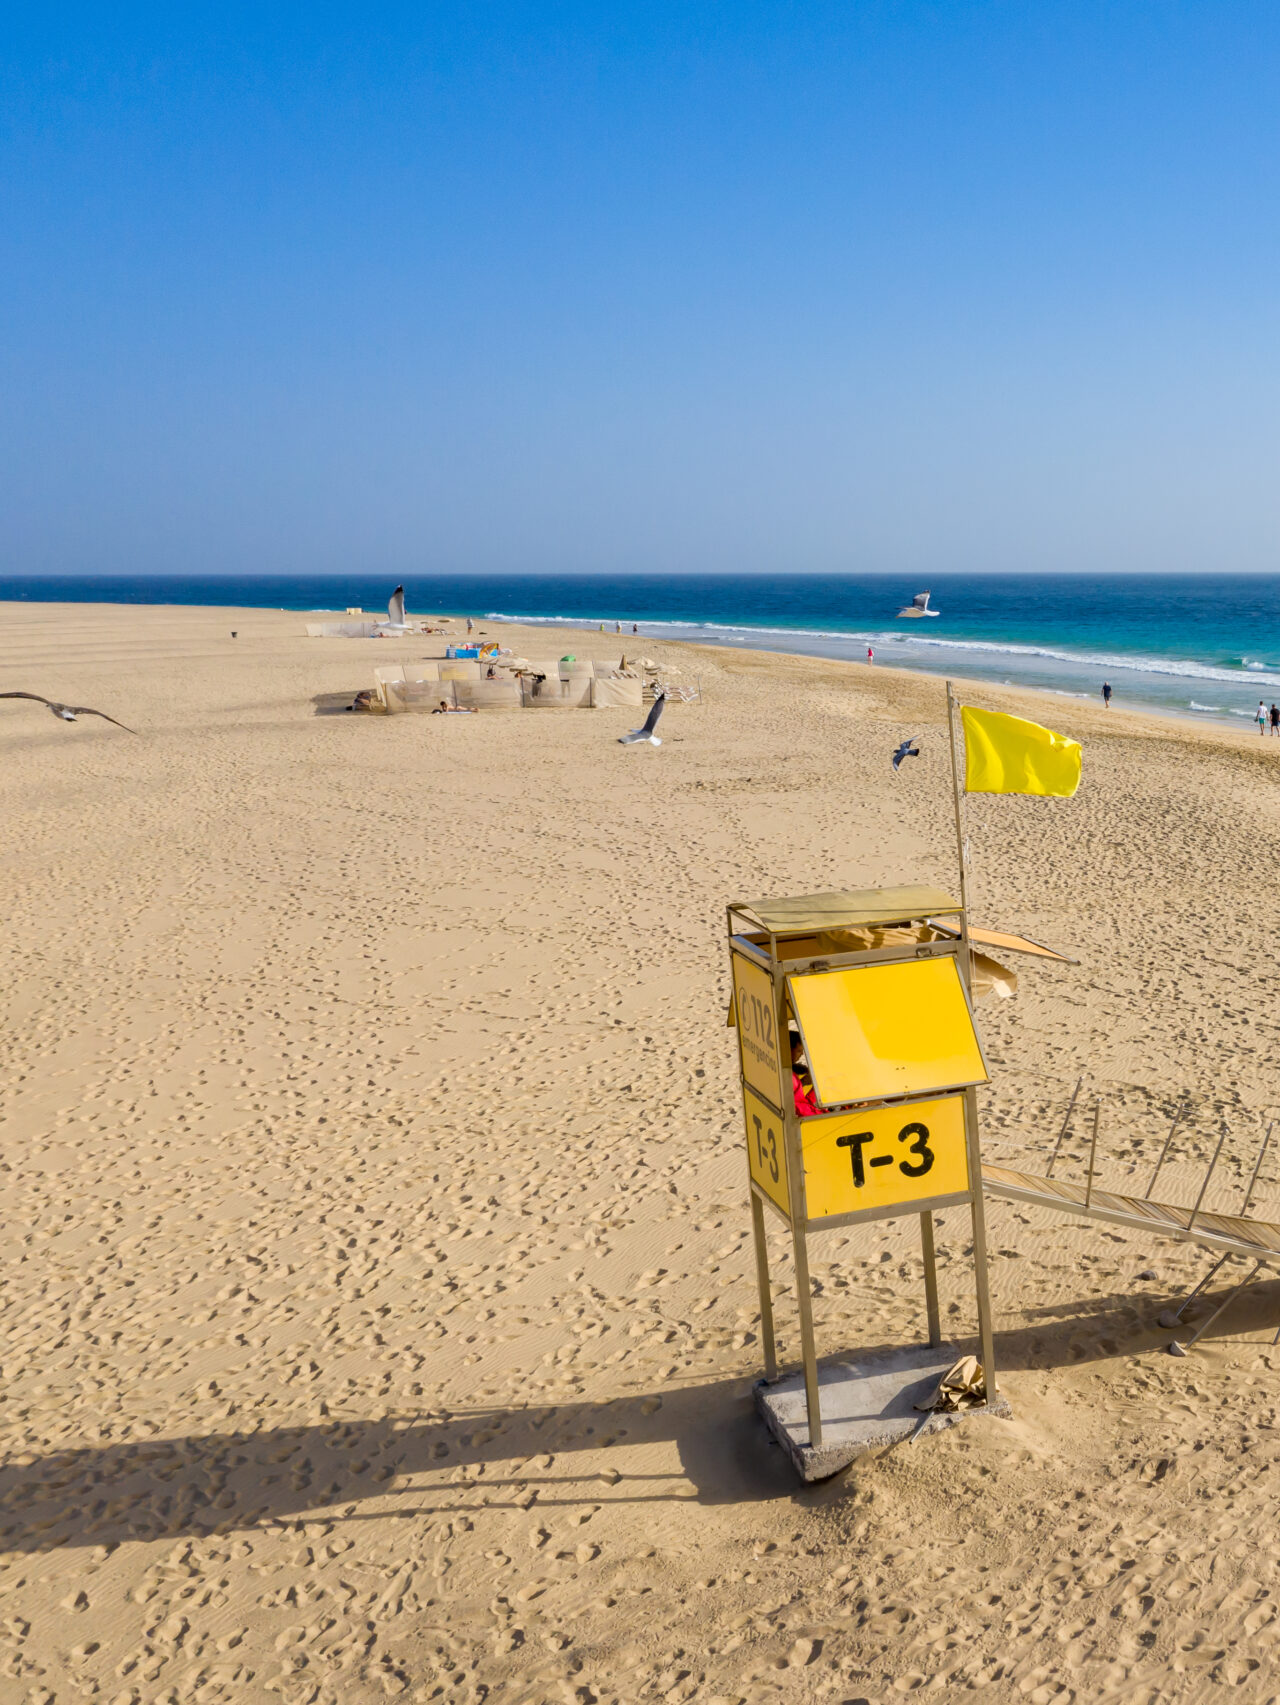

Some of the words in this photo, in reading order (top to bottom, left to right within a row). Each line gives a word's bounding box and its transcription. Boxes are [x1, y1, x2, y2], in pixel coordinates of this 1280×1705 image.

[751, 994, 774, 1050] 112
[753, 1114, 779, 1183] T-3
[836, 1122, 935, 1188] T-3
